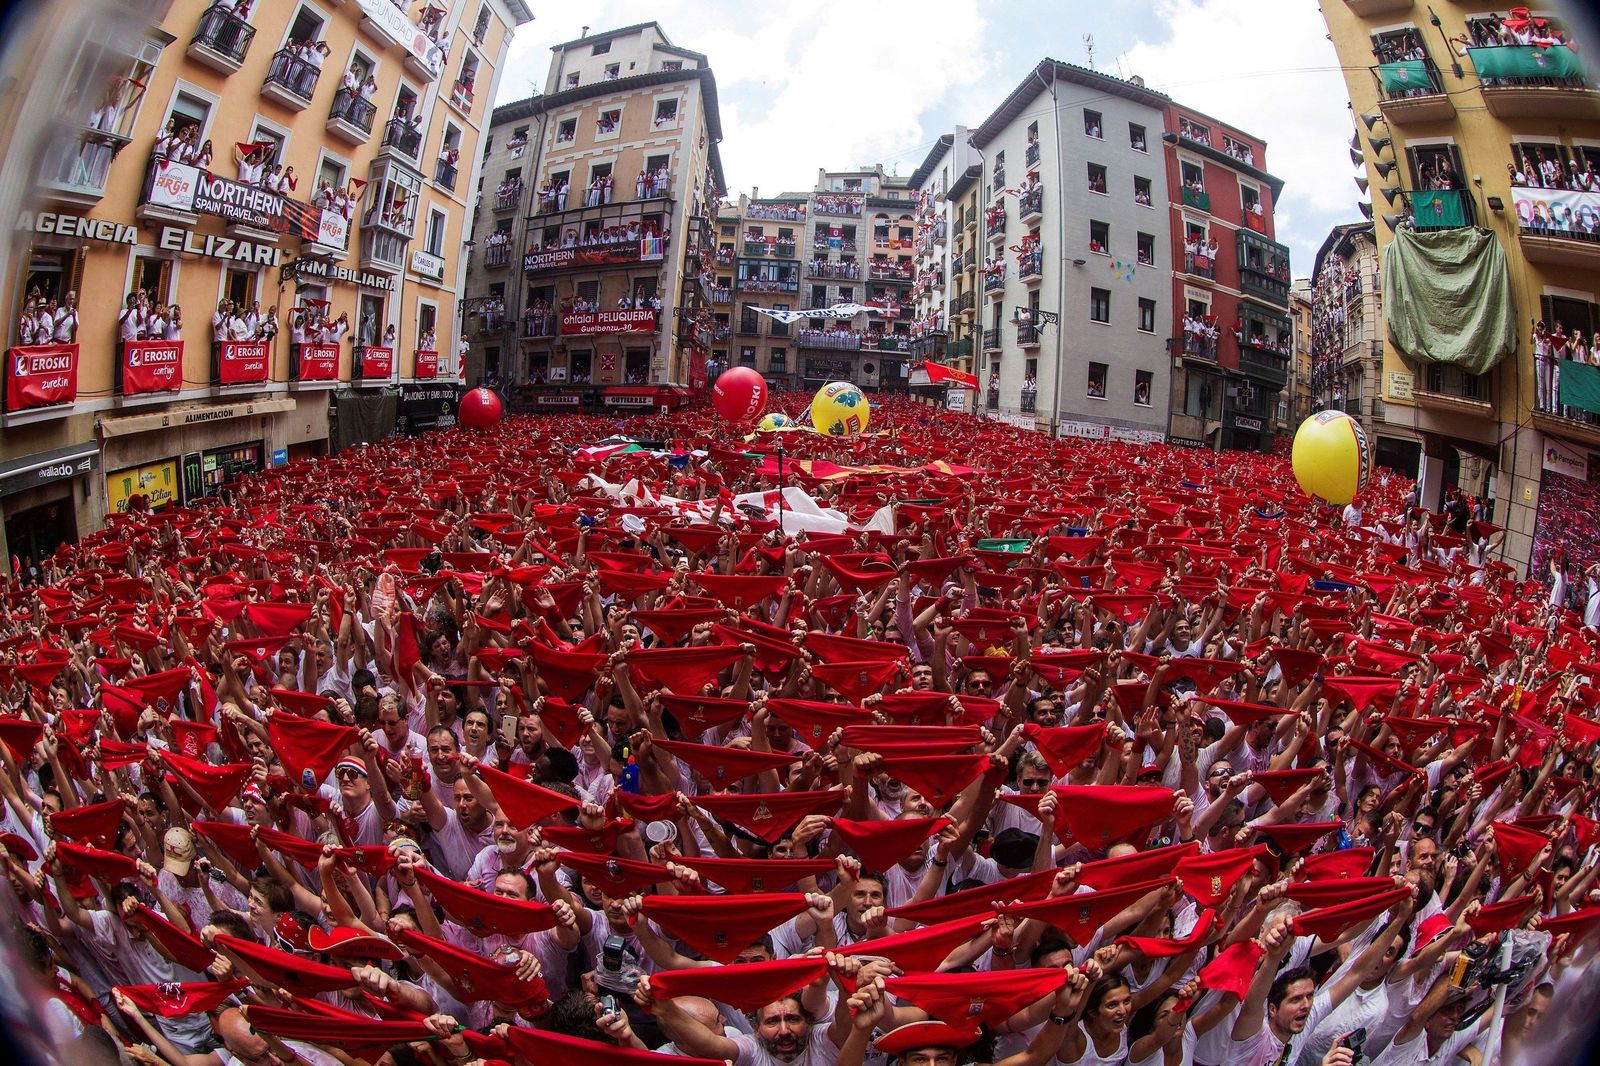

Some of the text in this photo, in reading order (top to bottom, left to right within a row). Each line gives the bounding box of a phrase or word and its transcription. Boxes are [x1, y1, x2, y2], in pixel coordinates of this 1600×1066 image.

[198, 176, 284, 217] NORTHERN
[195, 198, 270, 225] SPAIN TRAVEL.com
[15, 210, 139, 245] AGENCIA
[160, 226, 280, 267] ELIZARI
[524, 250, 575, 265] NORTHERN
[296, 257, 397, 292] INMBILIARIA
[598, 311, 654, 322] PELUQUERIA
[144, 348, 177, 362] EROSKI
[237, 347, 264, 357] EROSKI
[313, 349, 335, 358] EROSKI
[373, 351, 390, 359] EROSKI
[32, 356, 70, 372] EROSKI
[153, 365, 175, 380] contigo
[41, 376, 69, 390] zurekin
[742, 385, 761, 420] ROSKI
